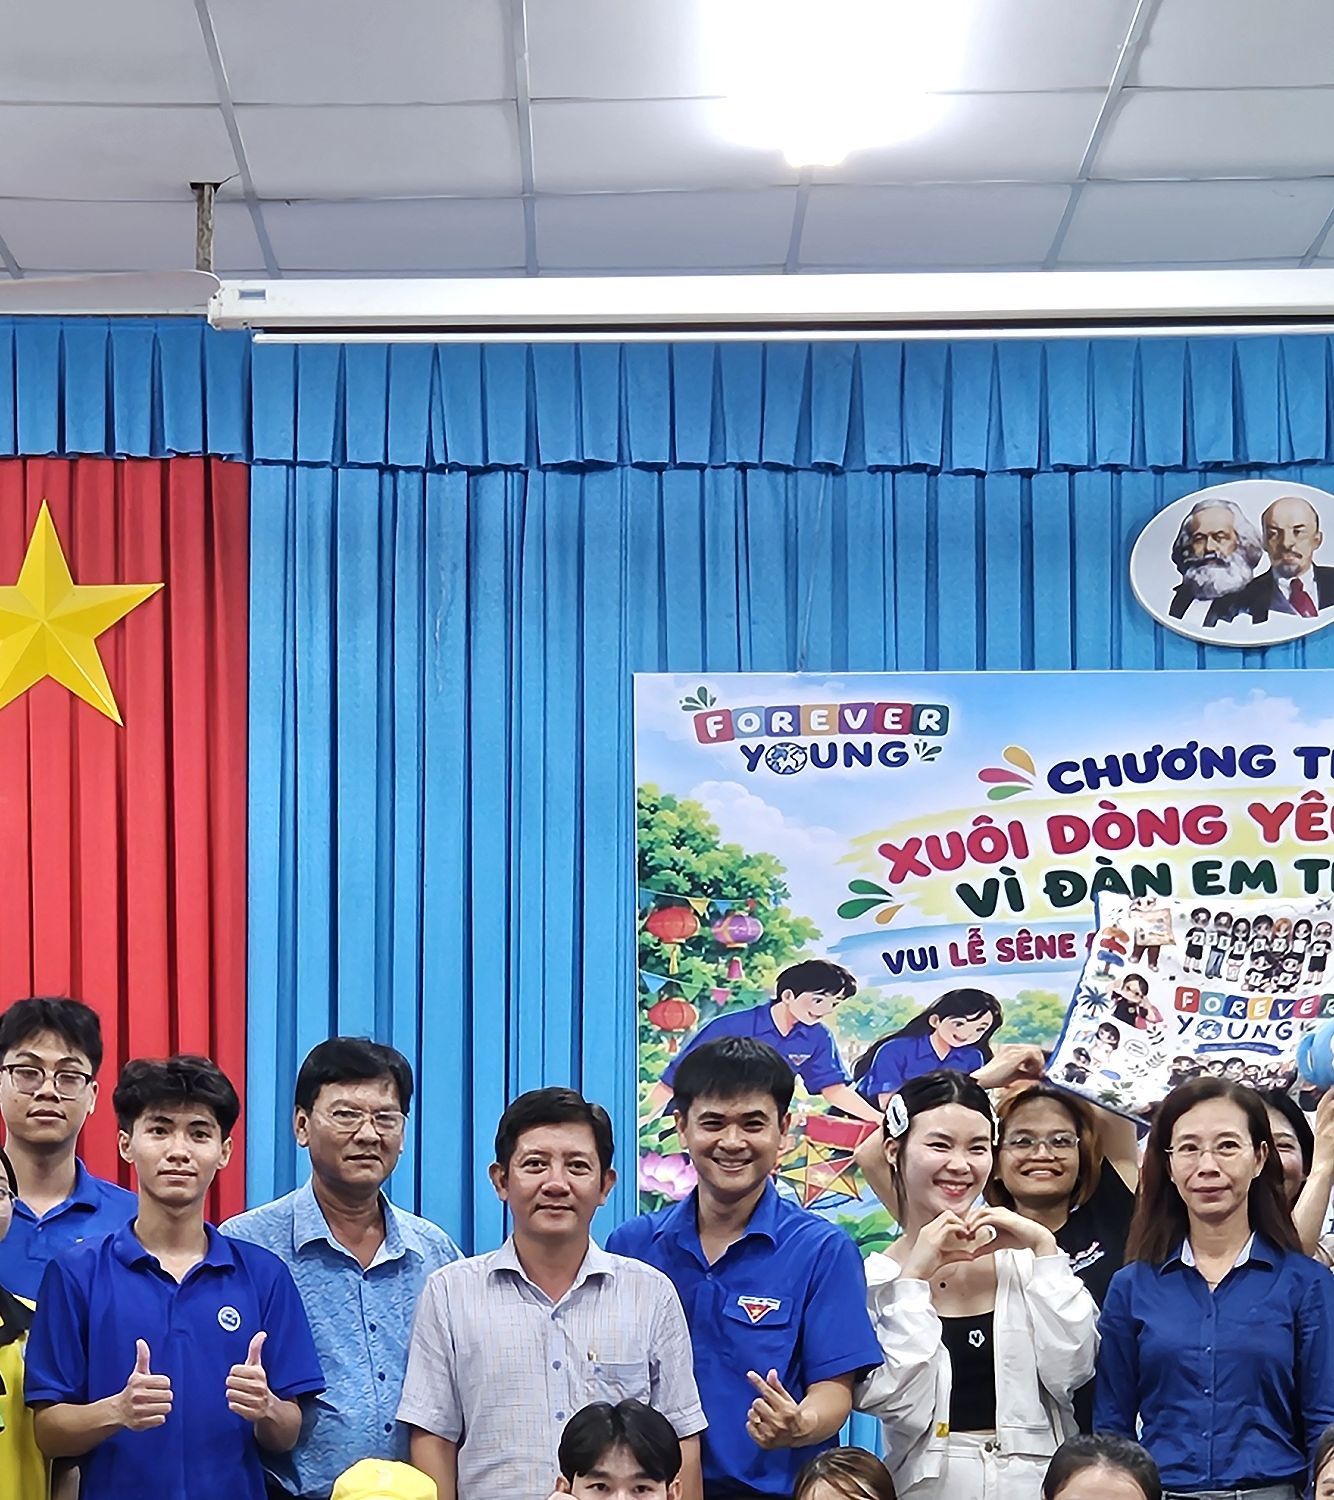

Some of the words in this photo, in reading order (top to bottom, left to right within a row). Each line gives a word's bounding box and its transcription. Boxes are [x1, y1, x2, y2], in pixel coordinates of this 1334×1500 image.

[703, 702, 945, 740] FOREVER
[740, 740, 911, 776] YOUNG
[1046, 739, 1274, 795] CHƯƠNG
[877, 813, 1030, 885] XUÔI
[1046, 799, 1228, 856] DÒNG
[955, 865, 1025, 919] VÌ
[1043, 855, 1174, 910] ĐÀN
[1190, 857, 1278, 896] EM
[882, 944, 940, 977] VUI
[948, 926, 987, 968] LỄ
[996, 927, 1077, 964] SÊNE
[1176, 1014, 1293, 1042] YOUNG
